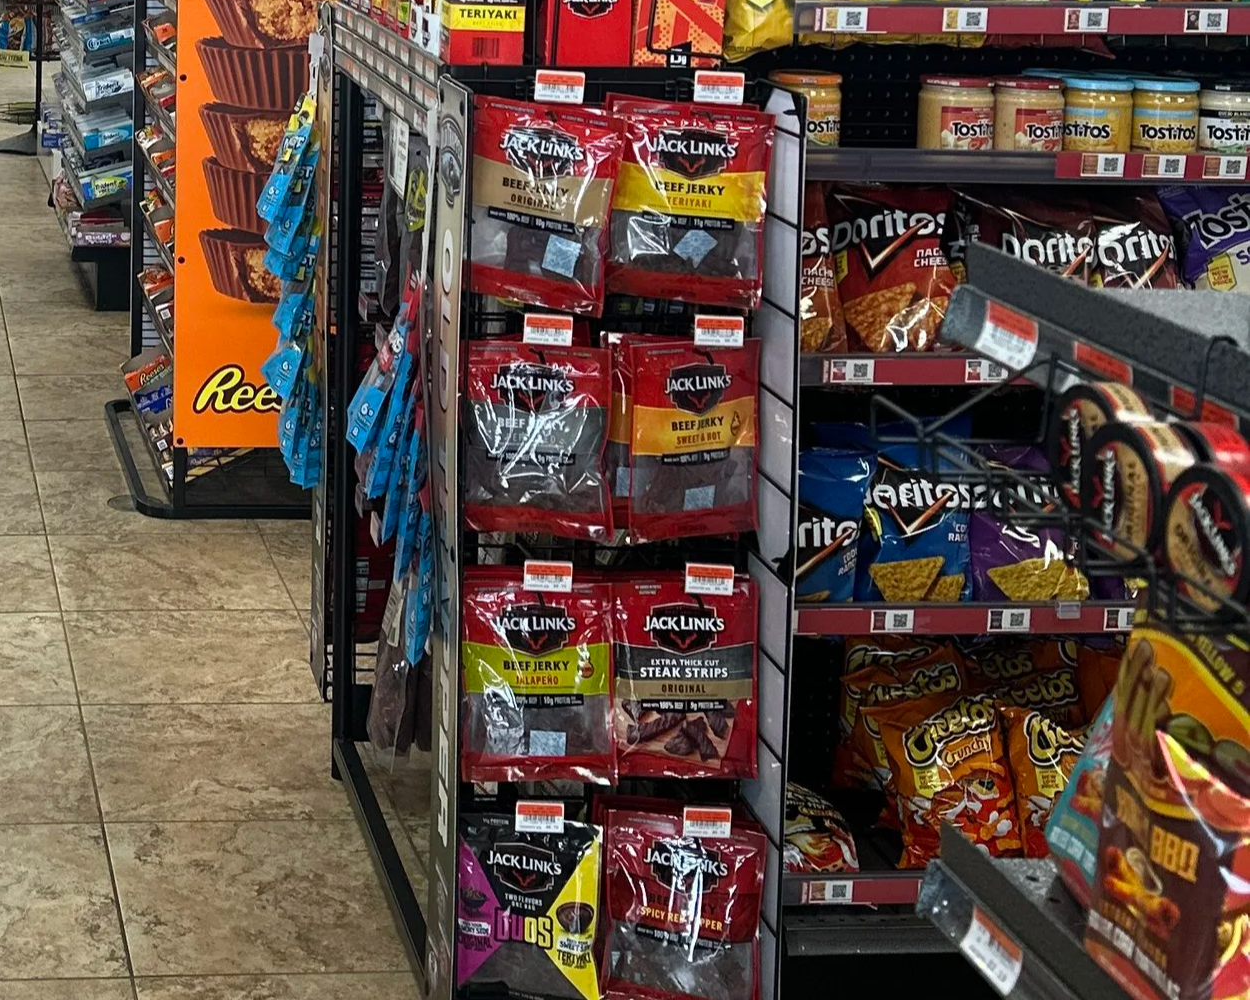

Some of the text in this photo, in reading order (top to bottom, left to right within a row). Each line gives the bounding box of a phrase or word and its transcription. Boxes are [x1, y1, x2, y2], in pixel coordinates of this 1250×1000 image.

[459, 8, 517, 20] TERIYAKI
[500, 133, 584, 162] JACK LINK'S
[650, 139, 736, 157] JACK LINK'S
[686, 182, 725, 197] JERKY
[490, 374, 574, 392] JACK LINK'S
[664, 374, 732, 394] JACK LINK'S
[671, 416, 724, 432] BEEF JERKY
[676, 433, 701, 445] SWEET
[707, 431, 721, 442] HOT
[532, 615, 576, 633] LINK'S
[643, 614, 725, 633] JACK LINK'S
[503, 660, 570, 672] BEEF JERKY
[651, 658, 719, 667] EXTRA THICK CUT
[640, 667, 729, 678] STEAK STRIPS
[661, 684, 706, 694] ORIGINAL
[904, 696, 995, 766] Cheetos
[941, 735, 992, 766] Crunchy
[487, 851, 561, 877] JACK LINK'S
[1151, 827, 1200, 884] BBQ
[505, 893, 517, 902] TWO
[494, 907, 553, 949] DUOS
